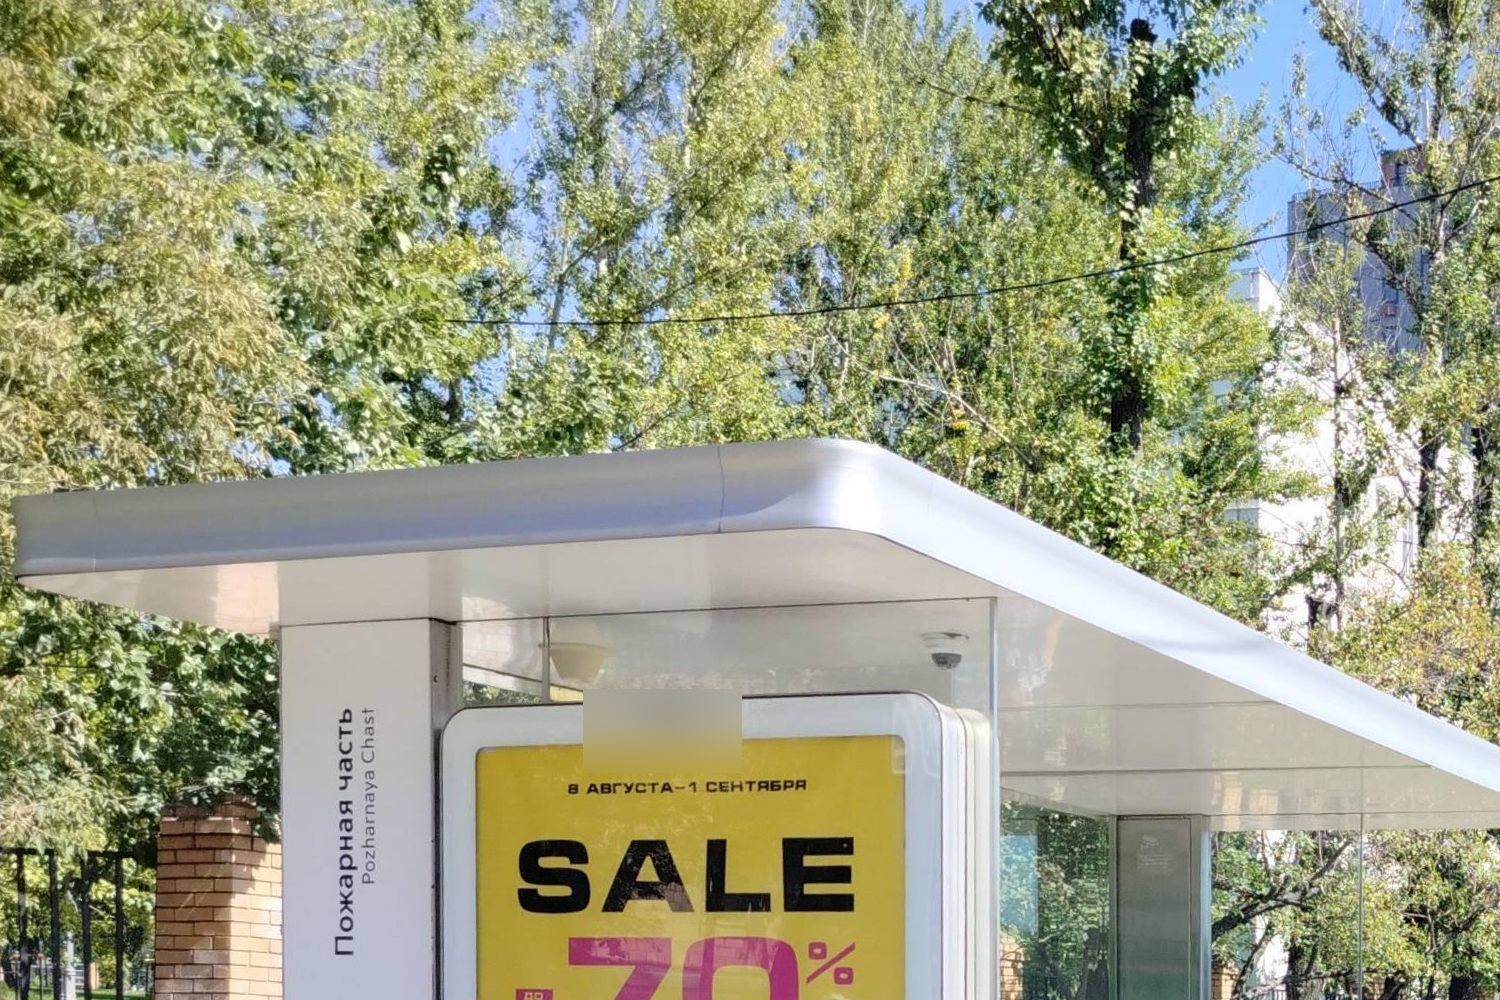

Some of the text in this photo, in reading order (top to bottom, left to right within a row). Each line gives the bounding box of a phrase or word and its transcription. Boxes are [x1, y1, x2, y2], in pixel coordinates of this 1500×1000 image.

[361, 708, 379, 885] Pozharnaya Chast
[567, 783, 579, 795] 8
[705, 779, 808, 793] СЕНТЯБРЯ
[335, 708, 358, 956] Пожарная часть
[517, 837, 855, 913] SALE
[523, 991, 544, 1000] ДО
